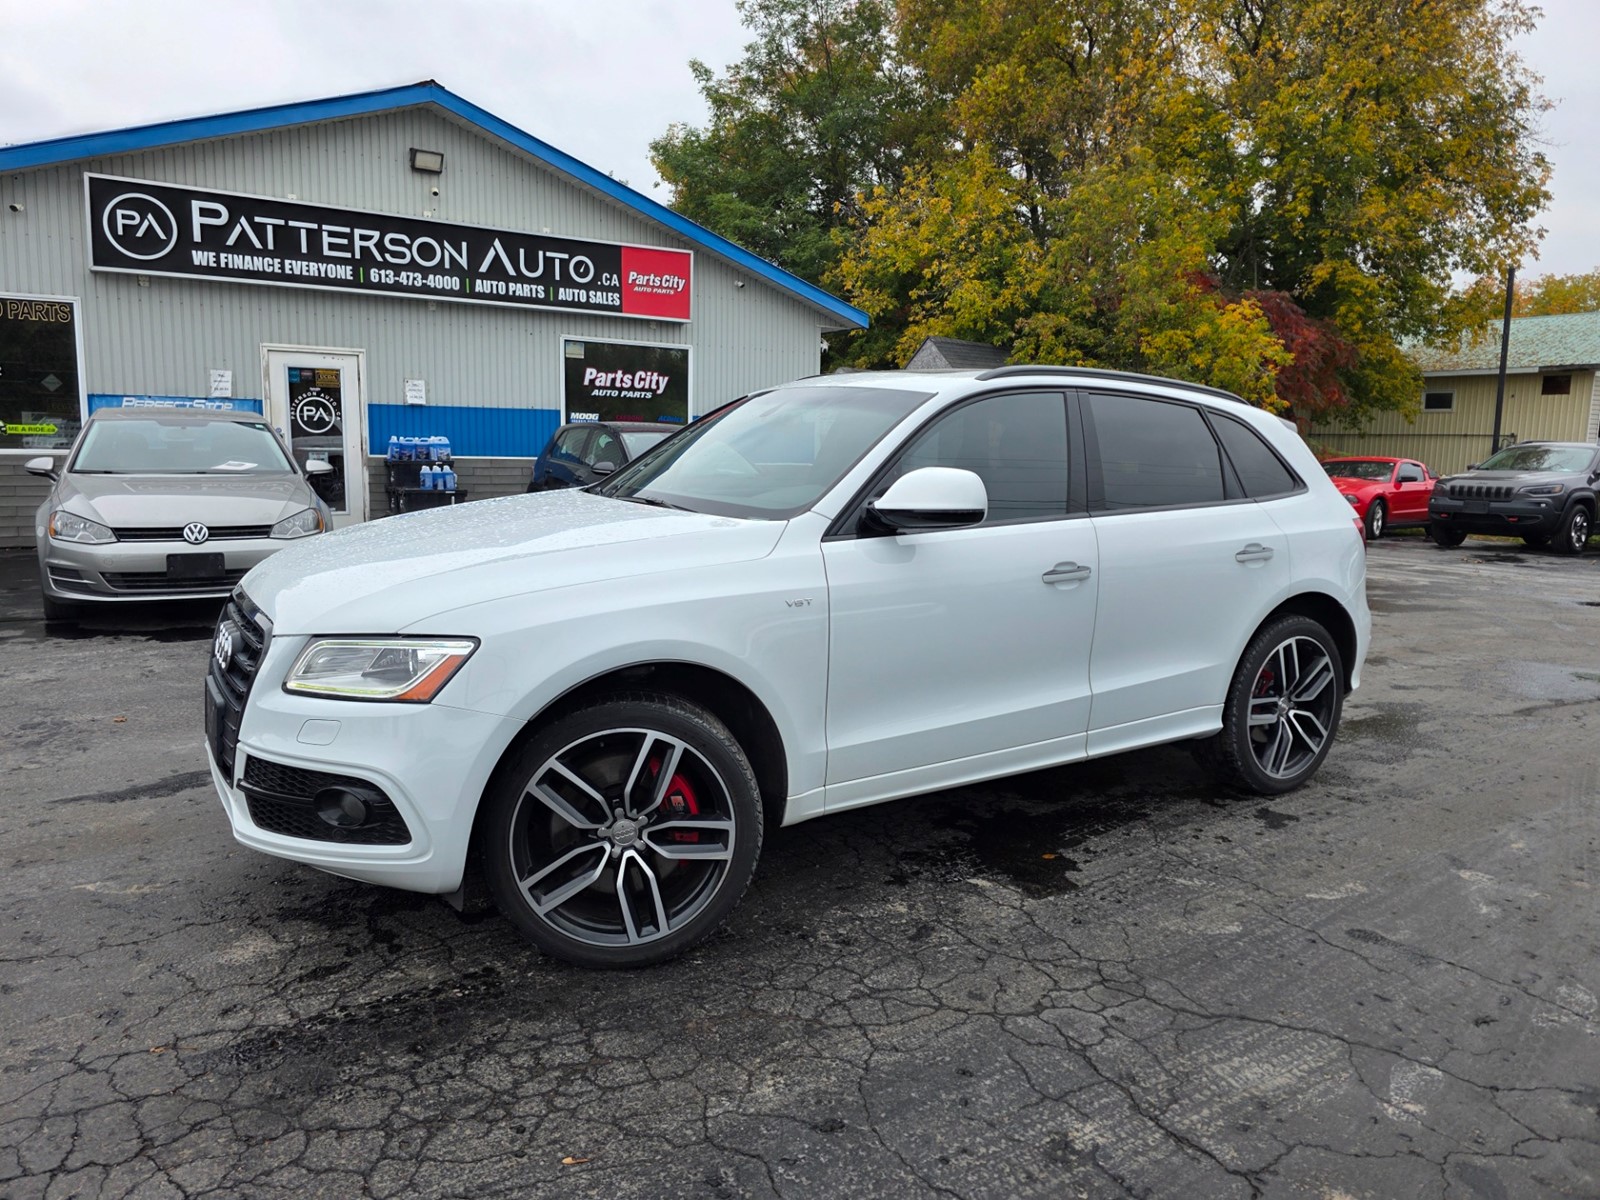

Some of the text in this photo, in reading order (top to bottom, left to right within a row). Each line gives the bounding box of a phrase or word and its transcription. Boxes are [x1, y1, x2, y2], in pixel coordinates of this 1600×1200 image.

[116, 208, 168, 240] PA
[190, 199, 468, 271] PATTERSON
[191, 250, 621, 307] WE FINANCE EVERYONE 613-473-4000 AUTO PARTS AUTO SALES
[633, 285, 675, 296] AUTO PARTS
[7, 300, 71, 323] PARTS
[290, 391, 317, 420] PATTERSON
[591, 389, 653, 399] AUTO PARTS
[570, 412, 600, 421] MOOG
